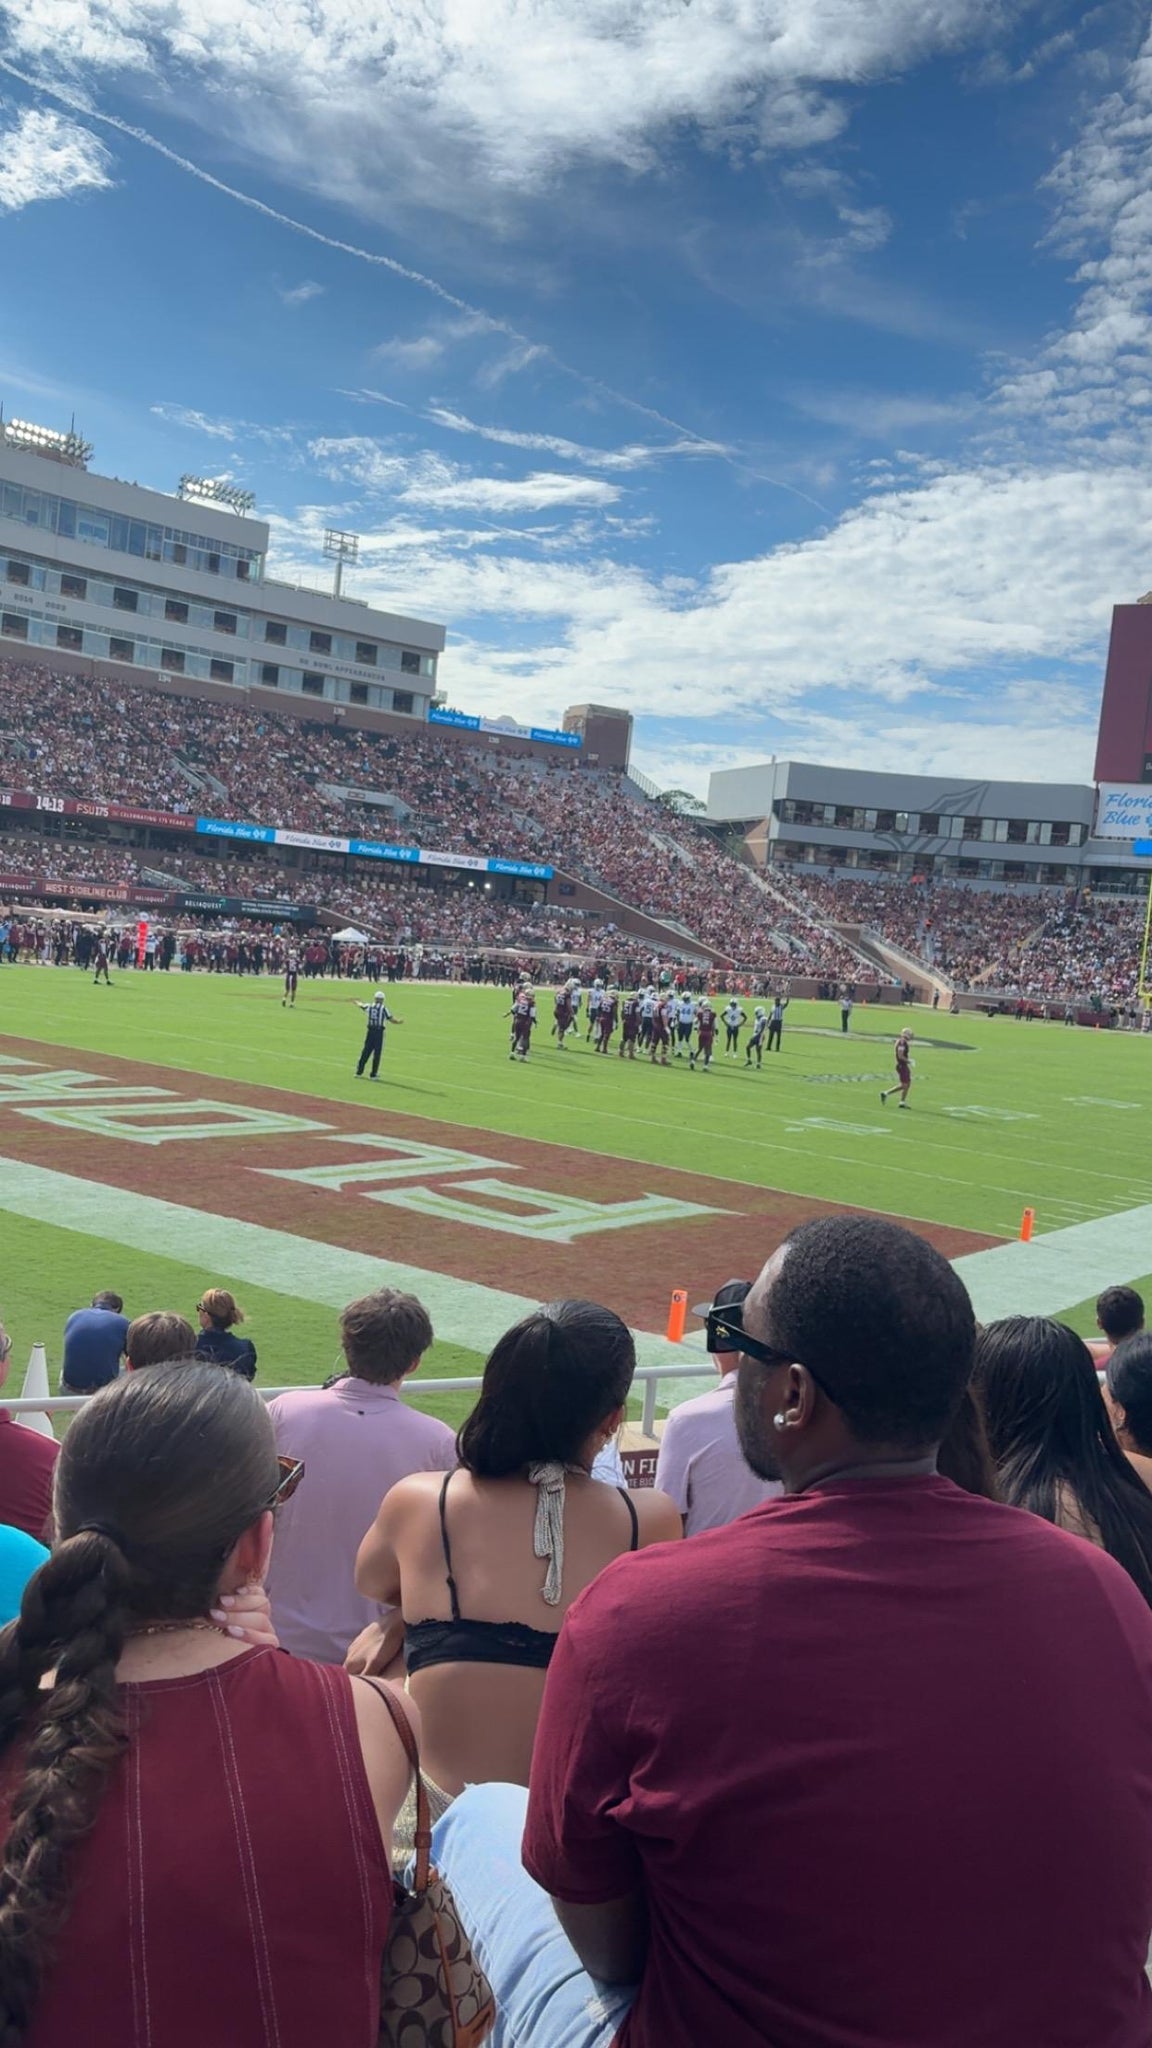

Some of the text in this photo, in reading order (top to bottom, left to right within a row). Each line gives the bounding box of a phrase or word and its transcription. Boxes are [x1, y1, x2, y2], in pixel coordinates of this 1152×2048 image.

[1103, 810, 1141, 825] Blue
[45, 883, 128, 899] WEST SIDELINE CLUB
[185, 900, 222, 910] RELIAQUEST
[681, 1007, 691, 1016] 44
